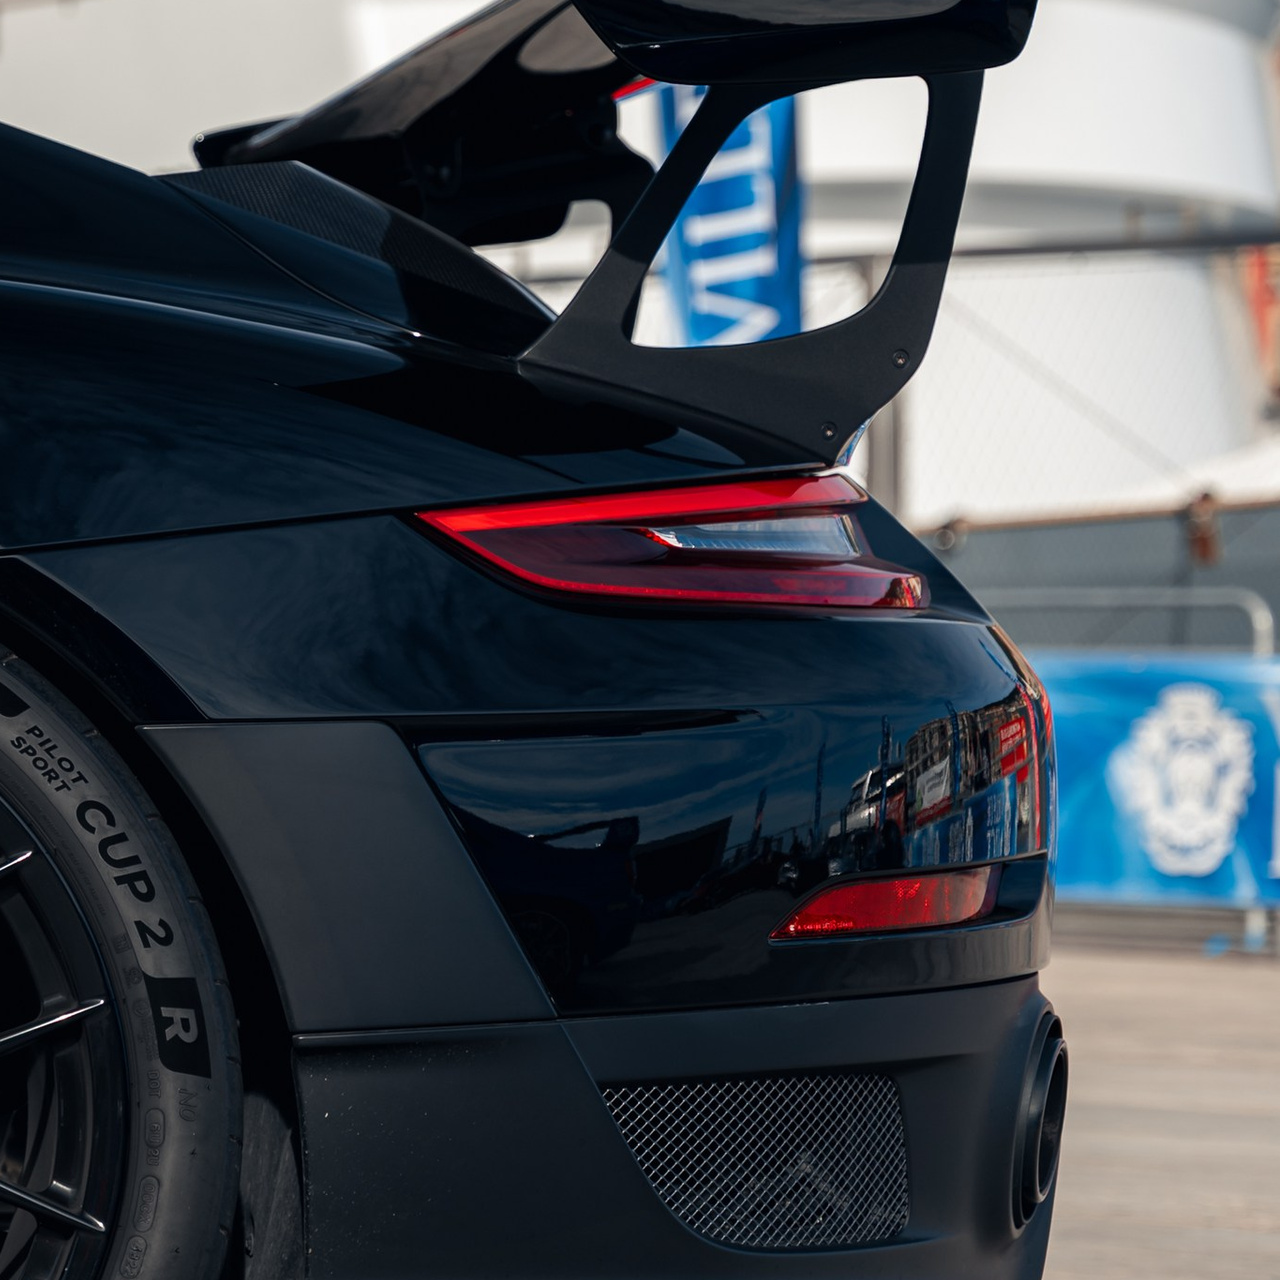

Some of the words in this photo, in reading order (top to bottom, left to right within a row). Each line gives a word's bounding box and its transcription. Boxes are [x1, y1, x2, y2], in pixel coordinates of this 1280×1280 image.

[675, 85, 780, 344] VILL
[10, 735, 72, 793] SPORT
[26, 726, 88, 785] PILOT
[76, 799, 156, 904] CUP
[134, 918, 174, 949] 2
[160, 1006, 198, 1043] R
